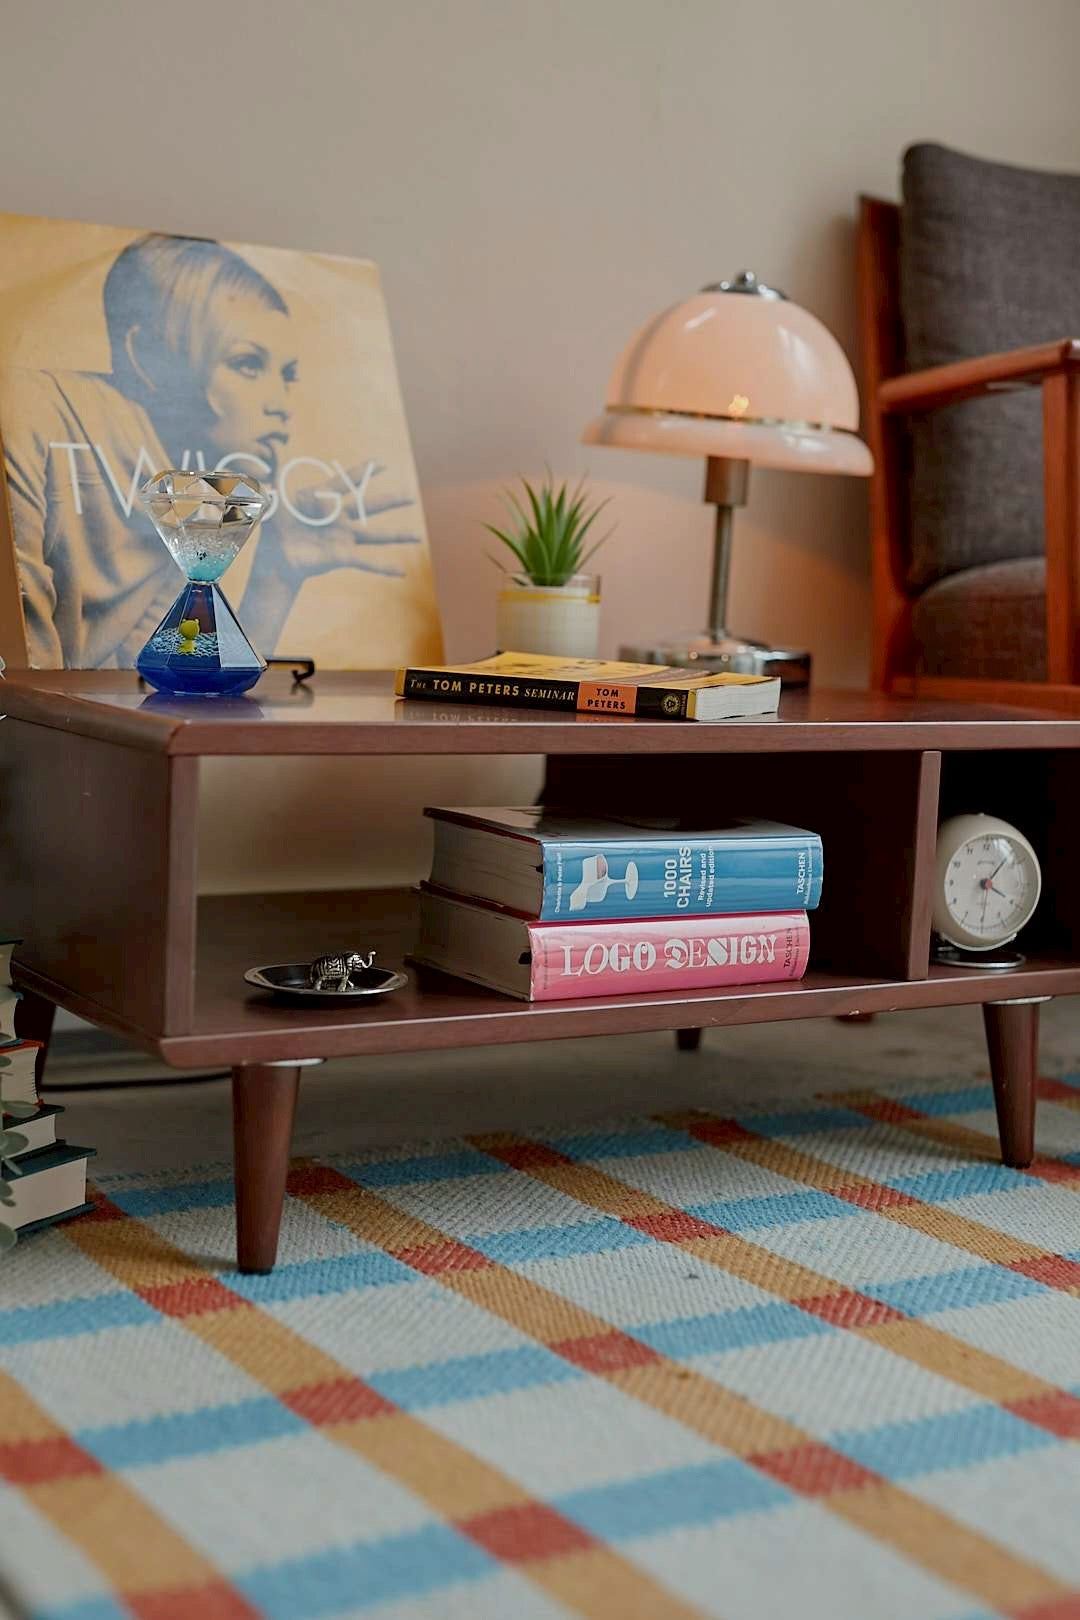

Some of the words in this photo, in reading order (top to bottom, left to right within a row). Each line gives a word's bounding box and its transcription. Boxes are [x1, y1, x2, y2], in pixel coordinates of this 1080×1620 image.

[49, 442, 376, 526] TWGGY
[433, 679, 462, 692] TOM
[469, 682, 520, 697] PETERS
[524, 687, 576, 701] SEMINAR
[587, 699, 626, 710] PETERS
[596, 687, 619, 698] TOM
[664, 858, 678, 898] 1000
[676, 846, 692, 909] CHAIRS
[697, 870, 707, 901] Revised
[705, 875, 715, 909] updated
[797, 852, 806, 895] TASCHEN
[560, 941, 657, 977] LOGO
[663, 934, 778, 969] DESIGN
[783, 927, 793, 969] TASCHEN
